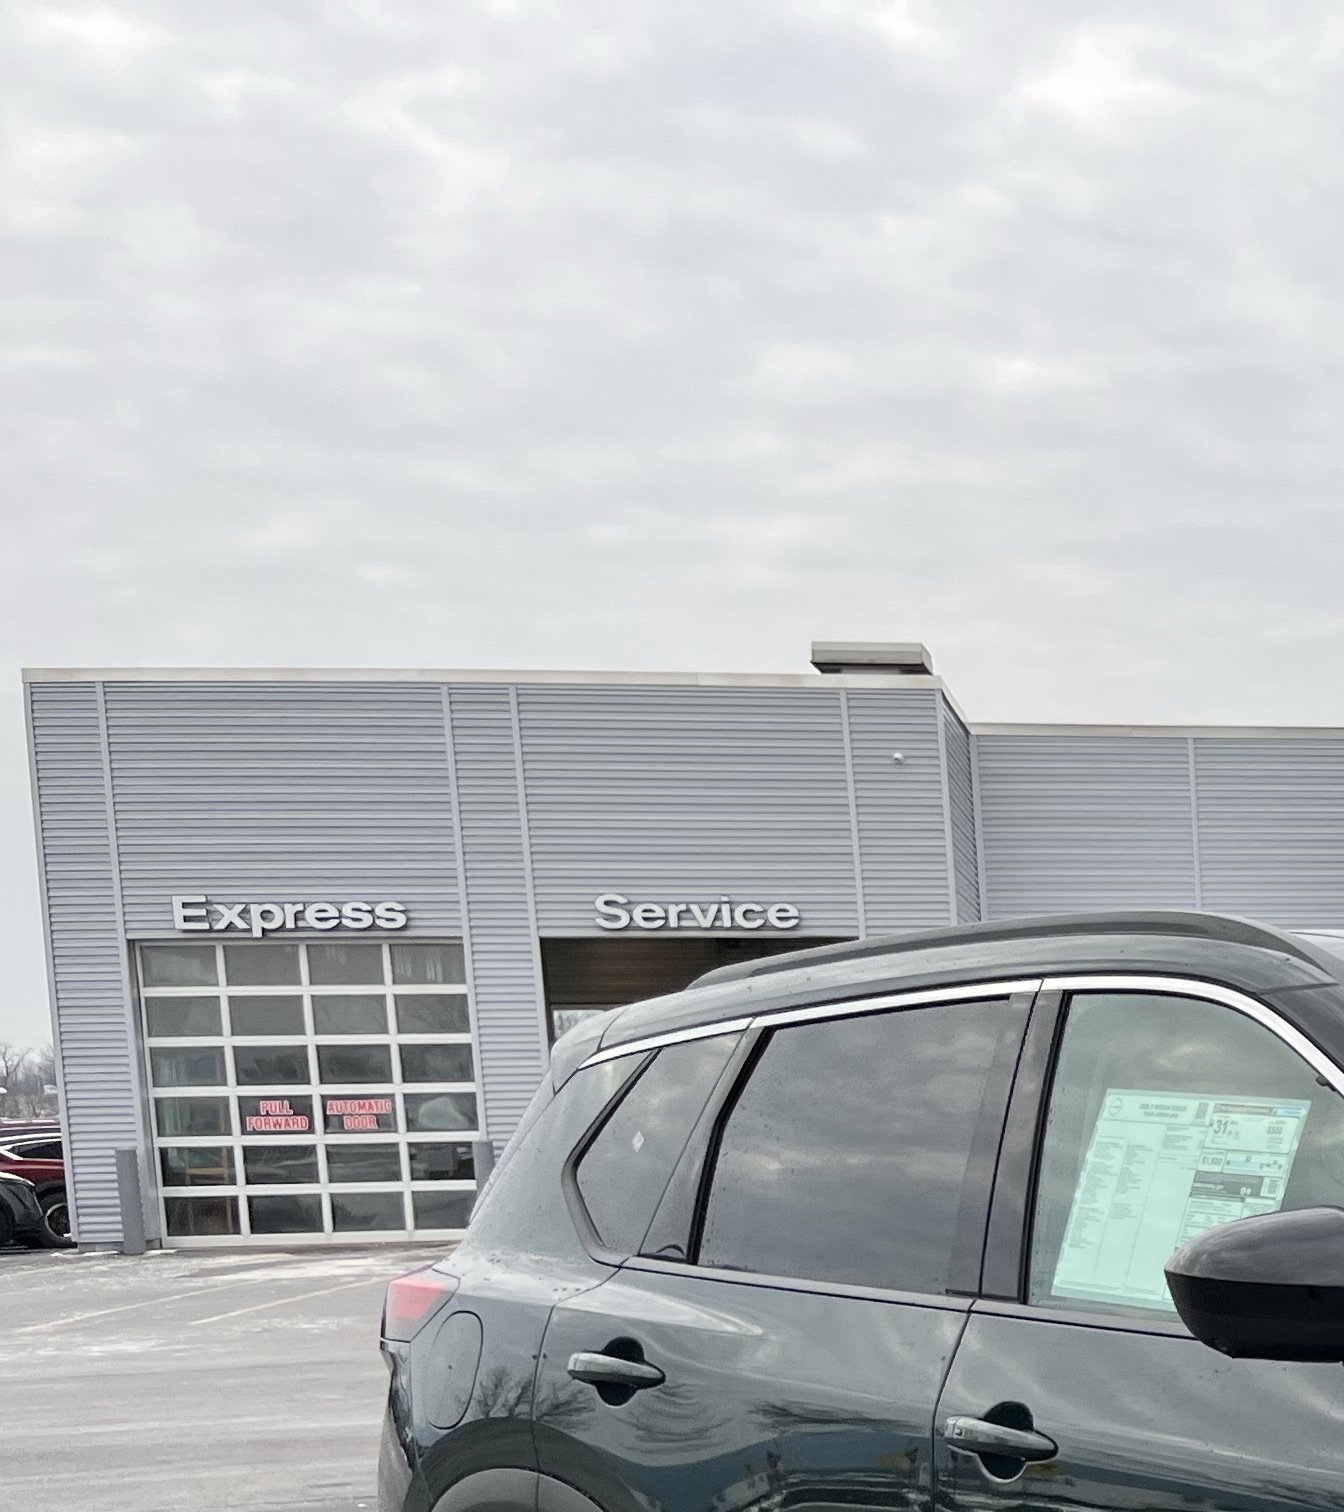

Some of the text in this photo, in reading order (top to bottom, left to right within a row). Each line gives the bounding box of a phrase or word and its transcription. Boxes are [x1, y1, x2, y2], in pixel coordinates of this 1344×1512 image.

[172, 895, 408, 938] Express
[594, 893, 800, 931] Service
[260, 1100, 293, 1115] PULL
[327, 1099, 392, 1115] AUTOMATIC
[246, 1116, 309, 1131] FORWARD
[343, 1115, 378, 1131] DOOR
